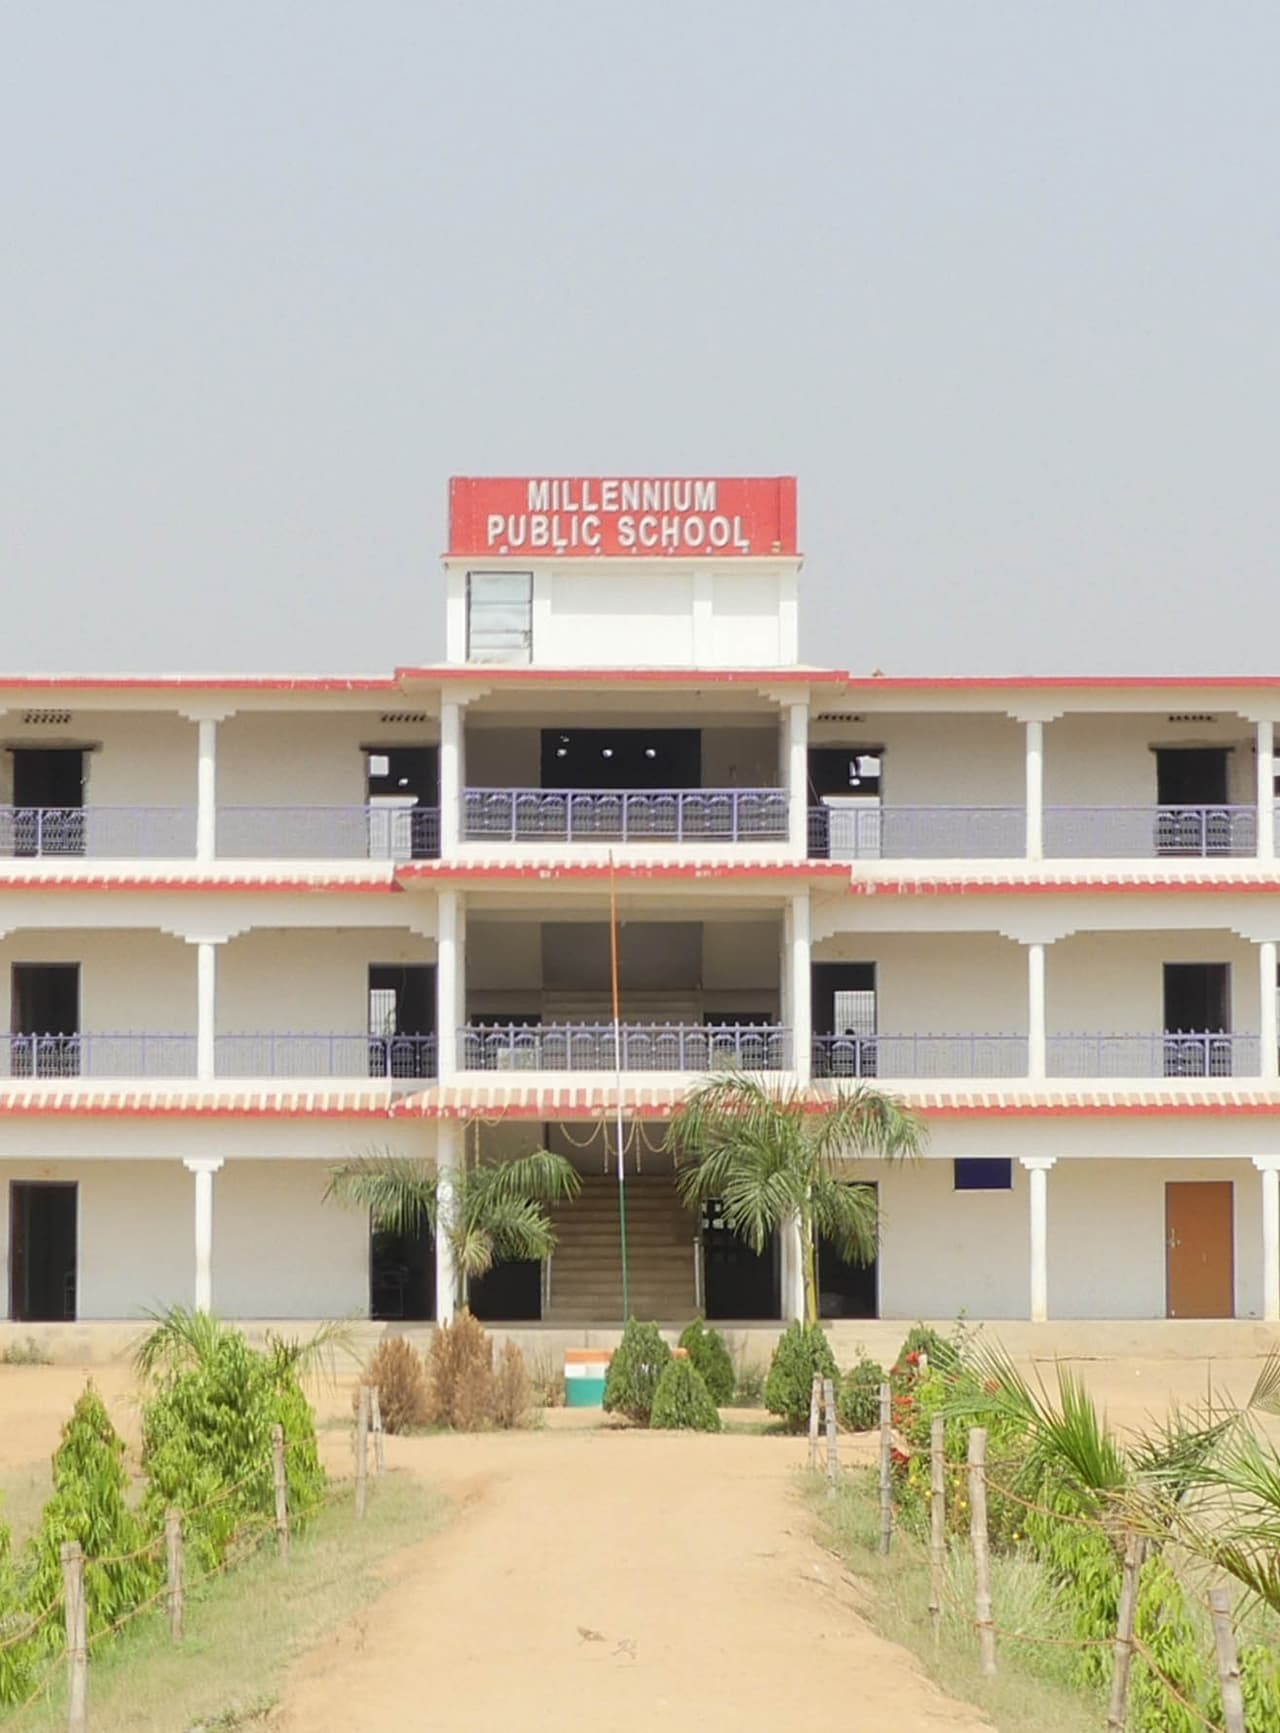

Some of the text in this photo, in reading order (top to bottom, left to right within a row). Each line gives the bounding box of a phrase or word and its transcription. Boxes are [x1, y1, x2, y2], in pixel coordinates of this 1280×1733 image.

[527, 480, 718, 512] MILLENNIUM
[487, 514, 750, 547] PUBLIC SCHOOL
